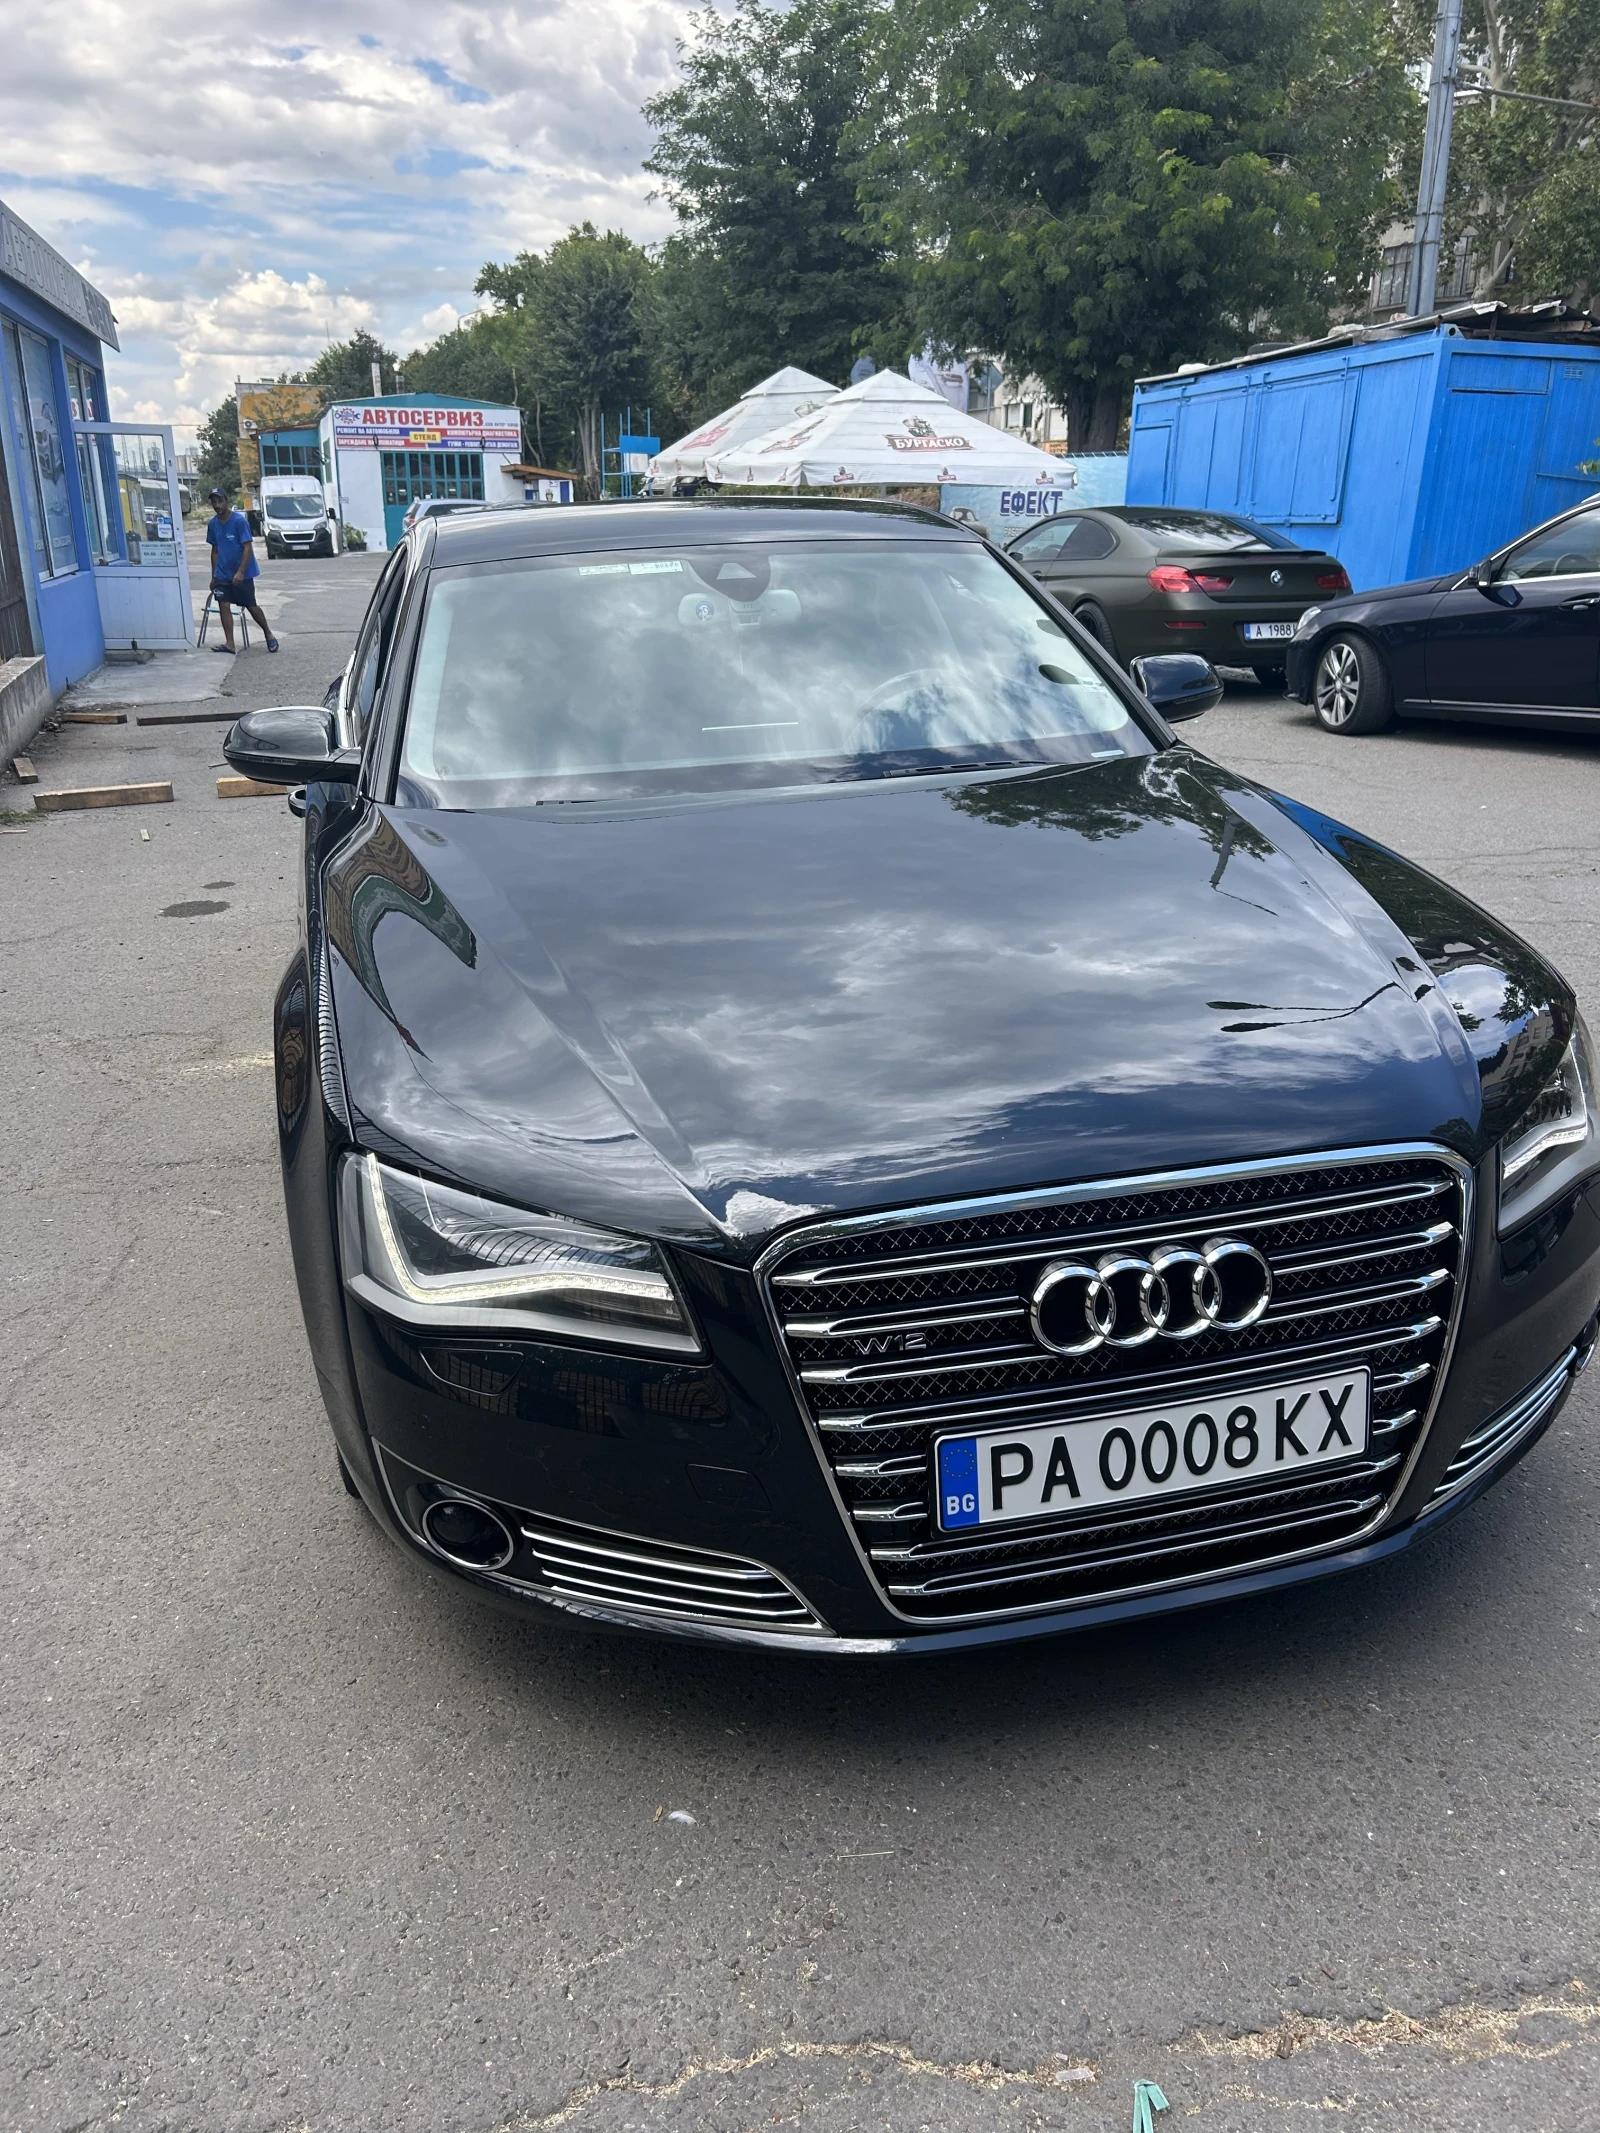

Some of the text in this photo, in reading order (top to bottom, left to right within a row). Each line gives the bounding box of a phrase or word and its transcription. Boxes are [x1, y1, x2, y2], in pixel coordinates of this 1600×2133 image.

[362, 409, 484, 427] АВТОСЕРВИЗ
[413, 433, 437, 441] СТЕНД
[894, 438, 964, 449] БУРГАСКО
[1000, 491, 1063, 515] ЕФЕКТ
[1256, 625, 1263, 637] A
[1269, 624, 1292, 637] 1988
[853, 1332, 927, 1355] W12
[946, 1383, 1355, 1516] BG PA 0008 KX
